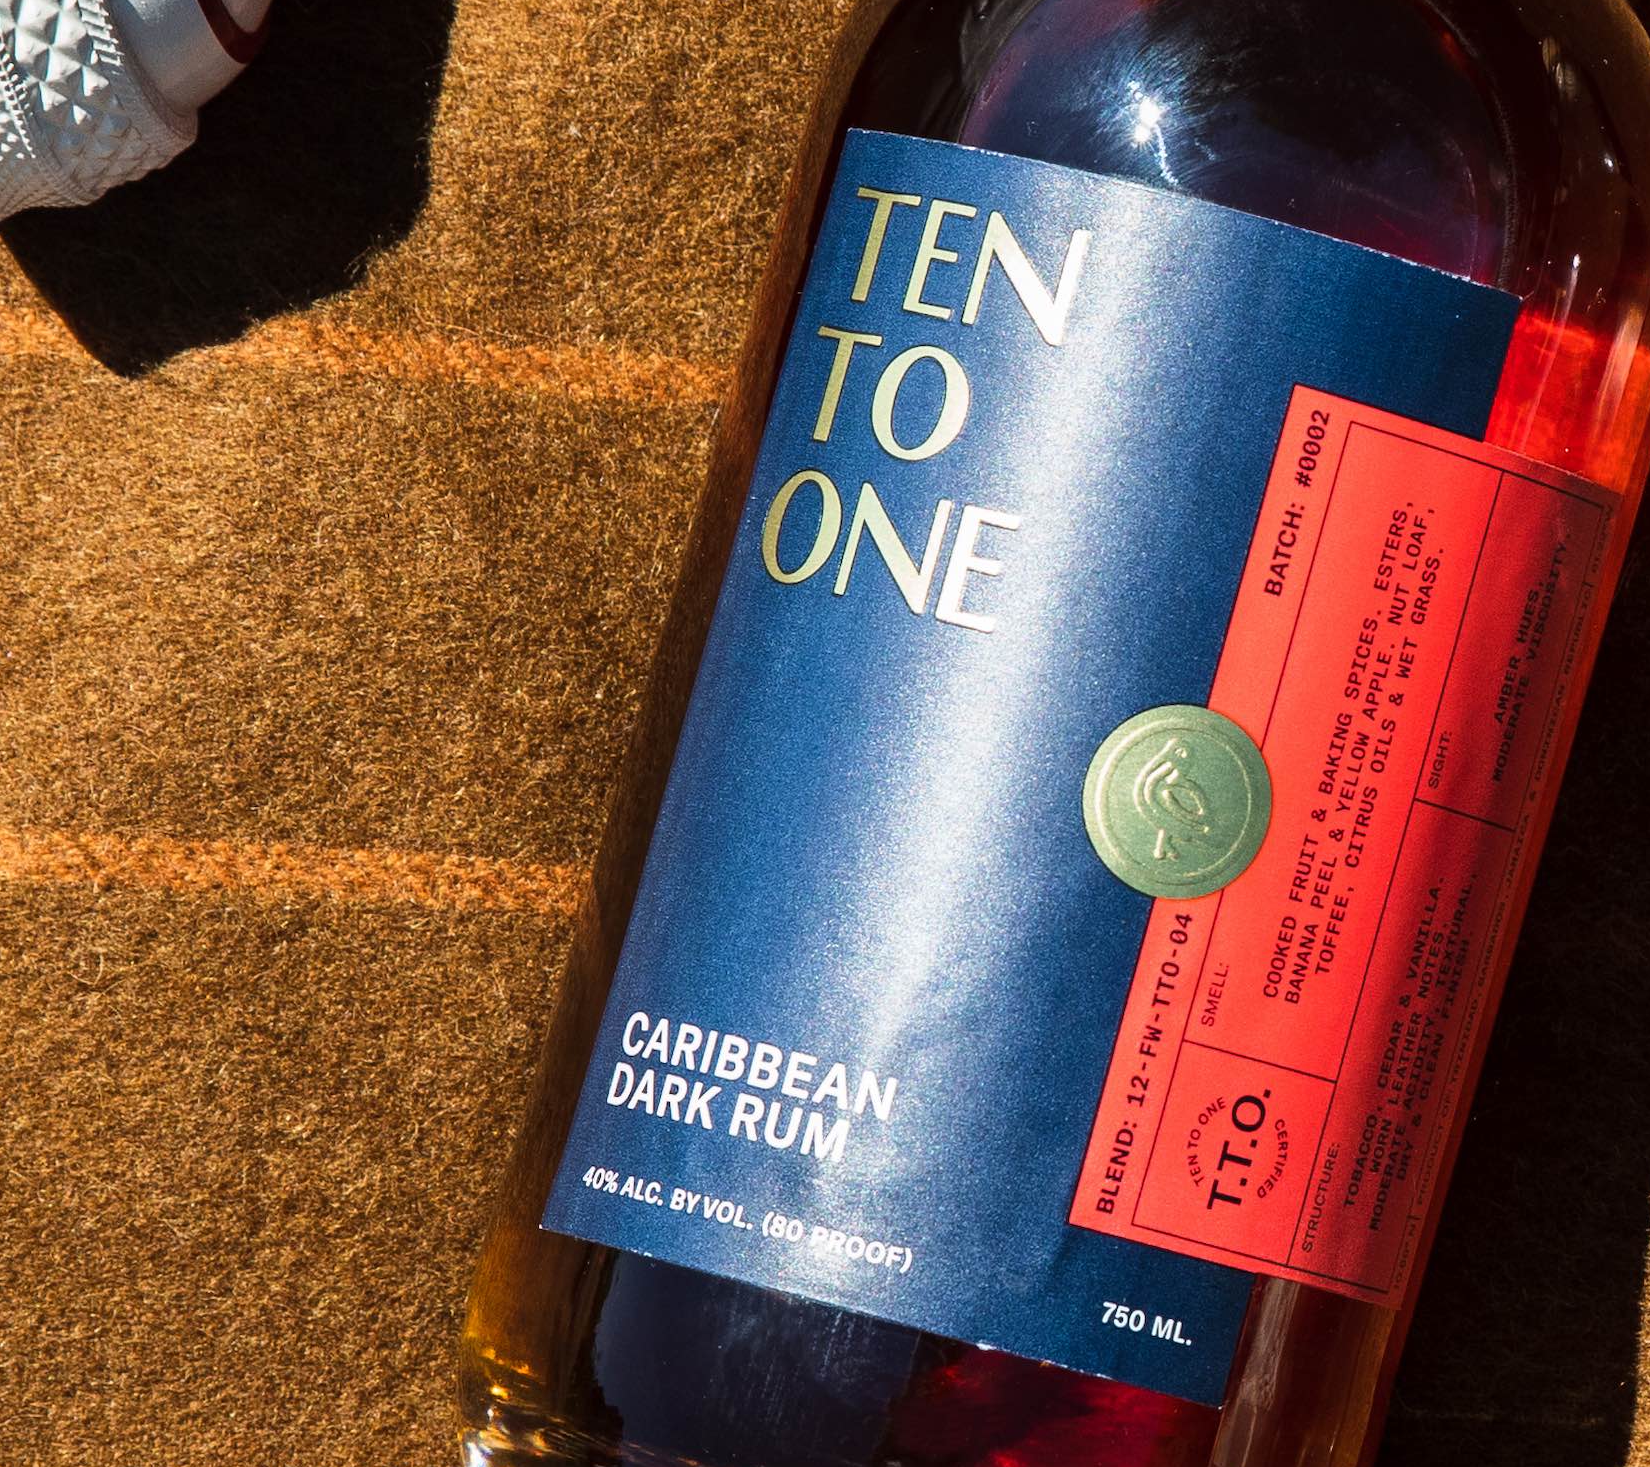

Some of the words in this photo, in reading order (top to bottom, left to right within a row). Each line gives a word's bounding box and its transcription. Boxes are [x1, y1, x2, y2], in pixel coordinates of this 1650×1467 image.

[851, 186, 1092, 347] TEN
[813, 326, 970, 461] TO
[1263, 500, 1305, 597] BATCH:
[1292, 407, 1331, 488] #0002
[1372, 497, 1414, 592] ESTERS,
[1401, 504, 1435, 572] LOAF,
[761, 470, 1021, 634] ONE
[1409, 544, 1445, 626] GRASS.
[1386, 582, 1412, 626] NUT
[1343, 606, 1382, 700] SPICES.
[1360, 639, 1396, 721] APPLE.
[1394, 635, 1420, 679] WET
[1491, 674, 1530, 783] MODERATE
[1525, 530, 1571, 663] VISCOSITY.
[1492, 654, 1521, 724] AMBER
[1386, 689, 1405, 707] &
[1316, 710, 1354, 795] BAKING
[1335, 731, 1371, 815] YELLOW
[1368, 716, 1397, 774] OILS
[1426, 729, 1453, 790] SIGHT:
[1309, 805, 1327, 823] &
[1327, 825, 1345, 843] &
[1343, 785, 1379, 869] CITRUS
[1287, 832, 1320, 903] FRUIT
[1309, 853, 1338, 909] PEEL
[1261, 914, 1298, 999] COOKED
[1283, 920, 1320, 1005] BANANA
[1314, 882, 1355, 977] TOFFEE,
[1199, 961, 1230, 1027] SMELL:
[622, 1011, 898, 1121] CARIBBEAN
[1095, 1118, 1138, 1216] BLEND:
[1123, 910, 1194, 1108] 12-FW-TTO-04
[1342, 1102, 1383, 1209] TOBACCO,
[1375, 1019, 1404, 1089] CEDAR
[1397, 992, 1412, 1008] &
[1405, 874, 1444, 982] VANILLA.
[607, 1062, 722, 1130] DARK
[728, 1093, 850, 1163] RUM
[1196, 1091, 1228, 1129] ONE
[1368, 1117, 1393, 1174] WORN
[1386, 1010, 1423, 1105] LEATHER
[1395, 1139, 1415, 1181] DRY
[1410, 1112, 1423, 1127] &
[1417, 1031, 1445, 1101] CLEAN
[1179, 1152, 1211, 1188] TEN
[1186, 1127, 1202, 1151] TO
[1205, 1081, 1272, 1217] T.T.O.
[1254, 1117, 1296, 1202] CERTIFIED
[1368, 1123, 1406, 1231] MODERATE
[582, 1166, 618, 1194] 40%
[620, 1175, 663, 1207] ALC.
[670, 1187, 699, 1214] BY
[702, 1196, 753, 1229] VOL.
[761, 1211, 804, 1244] (80
[811, 1225, 913, 1274] PROOF)
[1300, 1140, 1341, 1254] STRUCTURE:
[1102, 1301, 1145, 1332] 750
[1151, 1316, 1192, 1346] ML.
